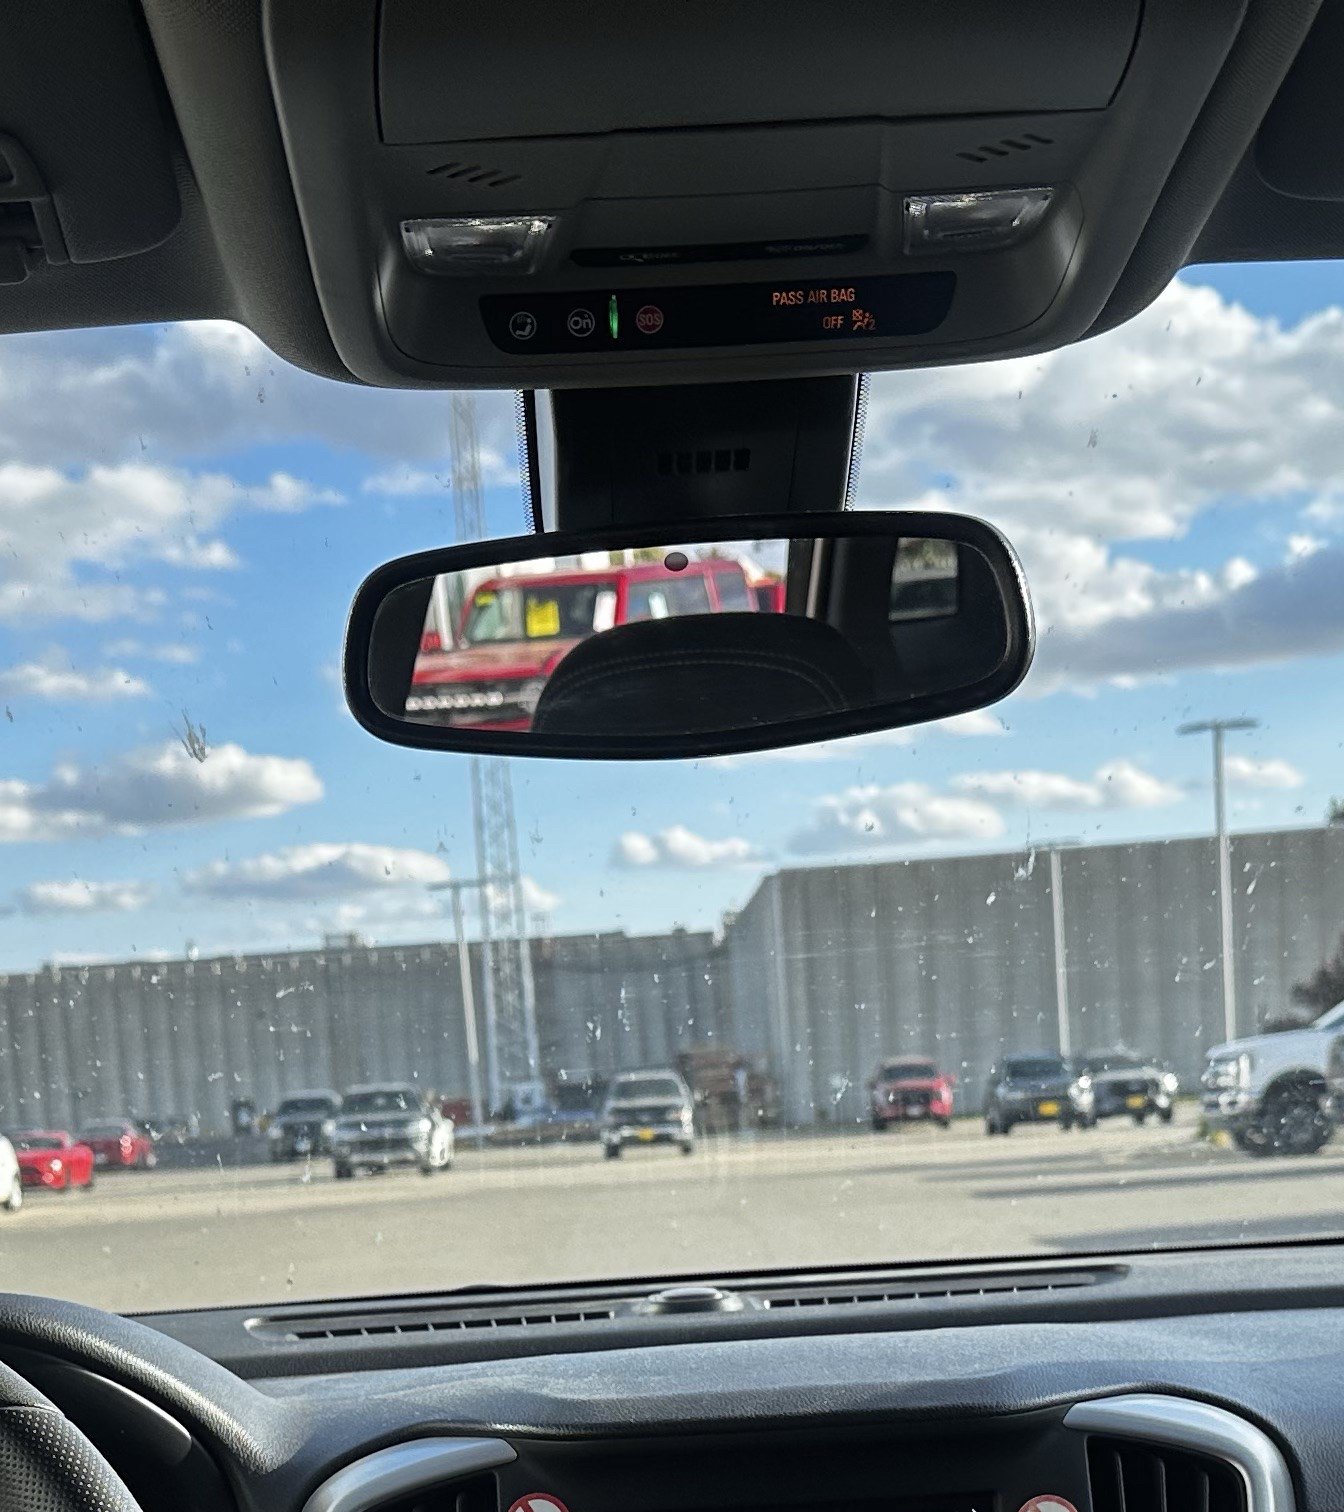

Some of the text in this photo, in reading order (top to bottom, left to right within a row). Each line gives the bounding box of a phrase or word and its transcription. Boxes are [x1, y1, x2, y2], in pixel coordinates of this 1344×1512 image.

[772, 287, 855, 305] PASS AIR BAG
[638, 312, 660, 326] SOS
[822, 315, 844, 329] OFF
